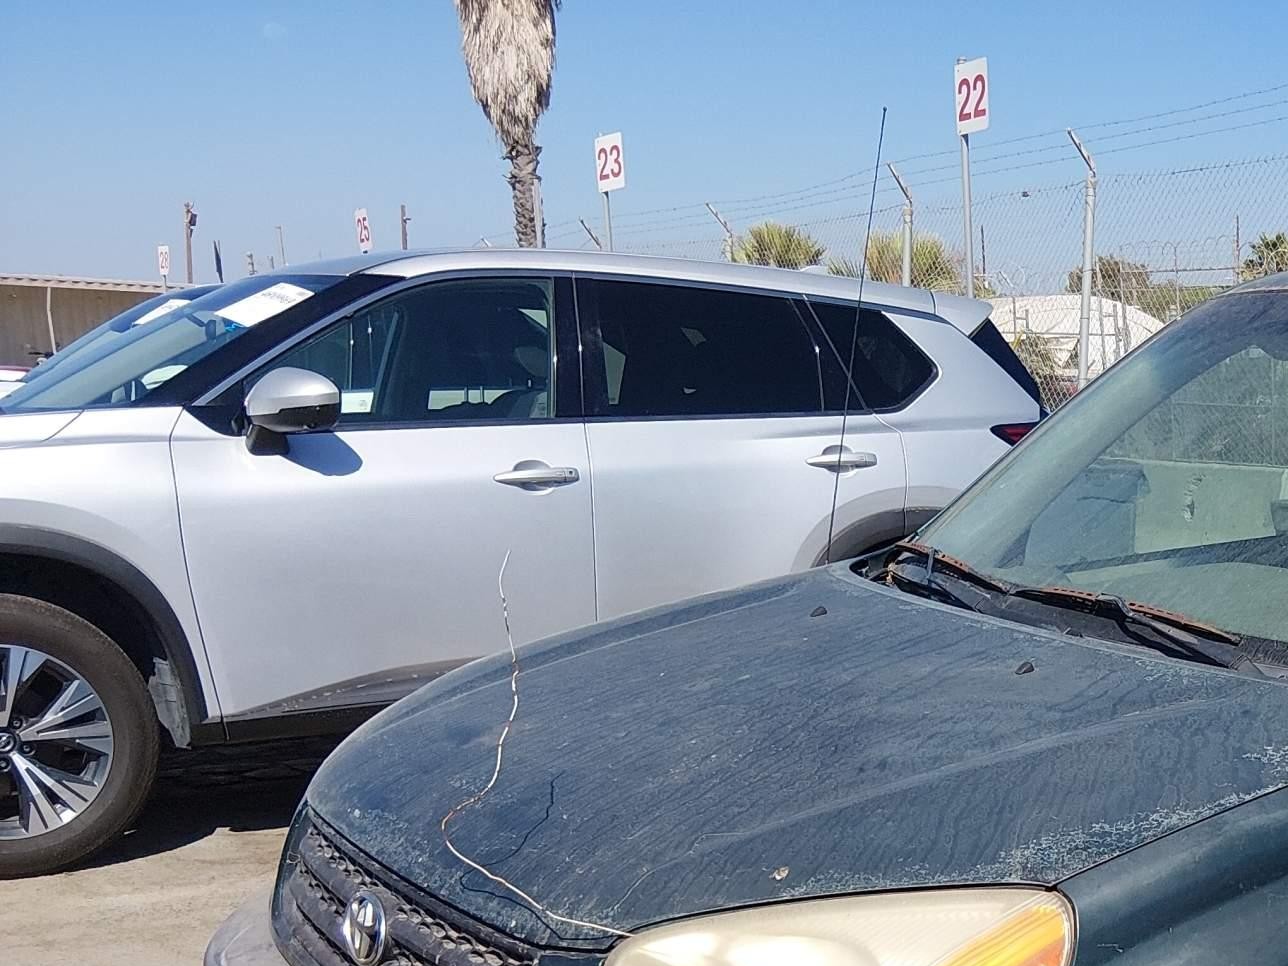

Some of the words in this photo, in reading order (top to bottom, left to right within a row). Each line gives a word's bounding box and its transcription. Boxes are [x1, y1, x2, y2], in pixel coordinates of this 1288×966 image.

[957, 73, 987, 122] 22
[597, 144, 622, 181] 23
[356, 216, 370, 243] 25
